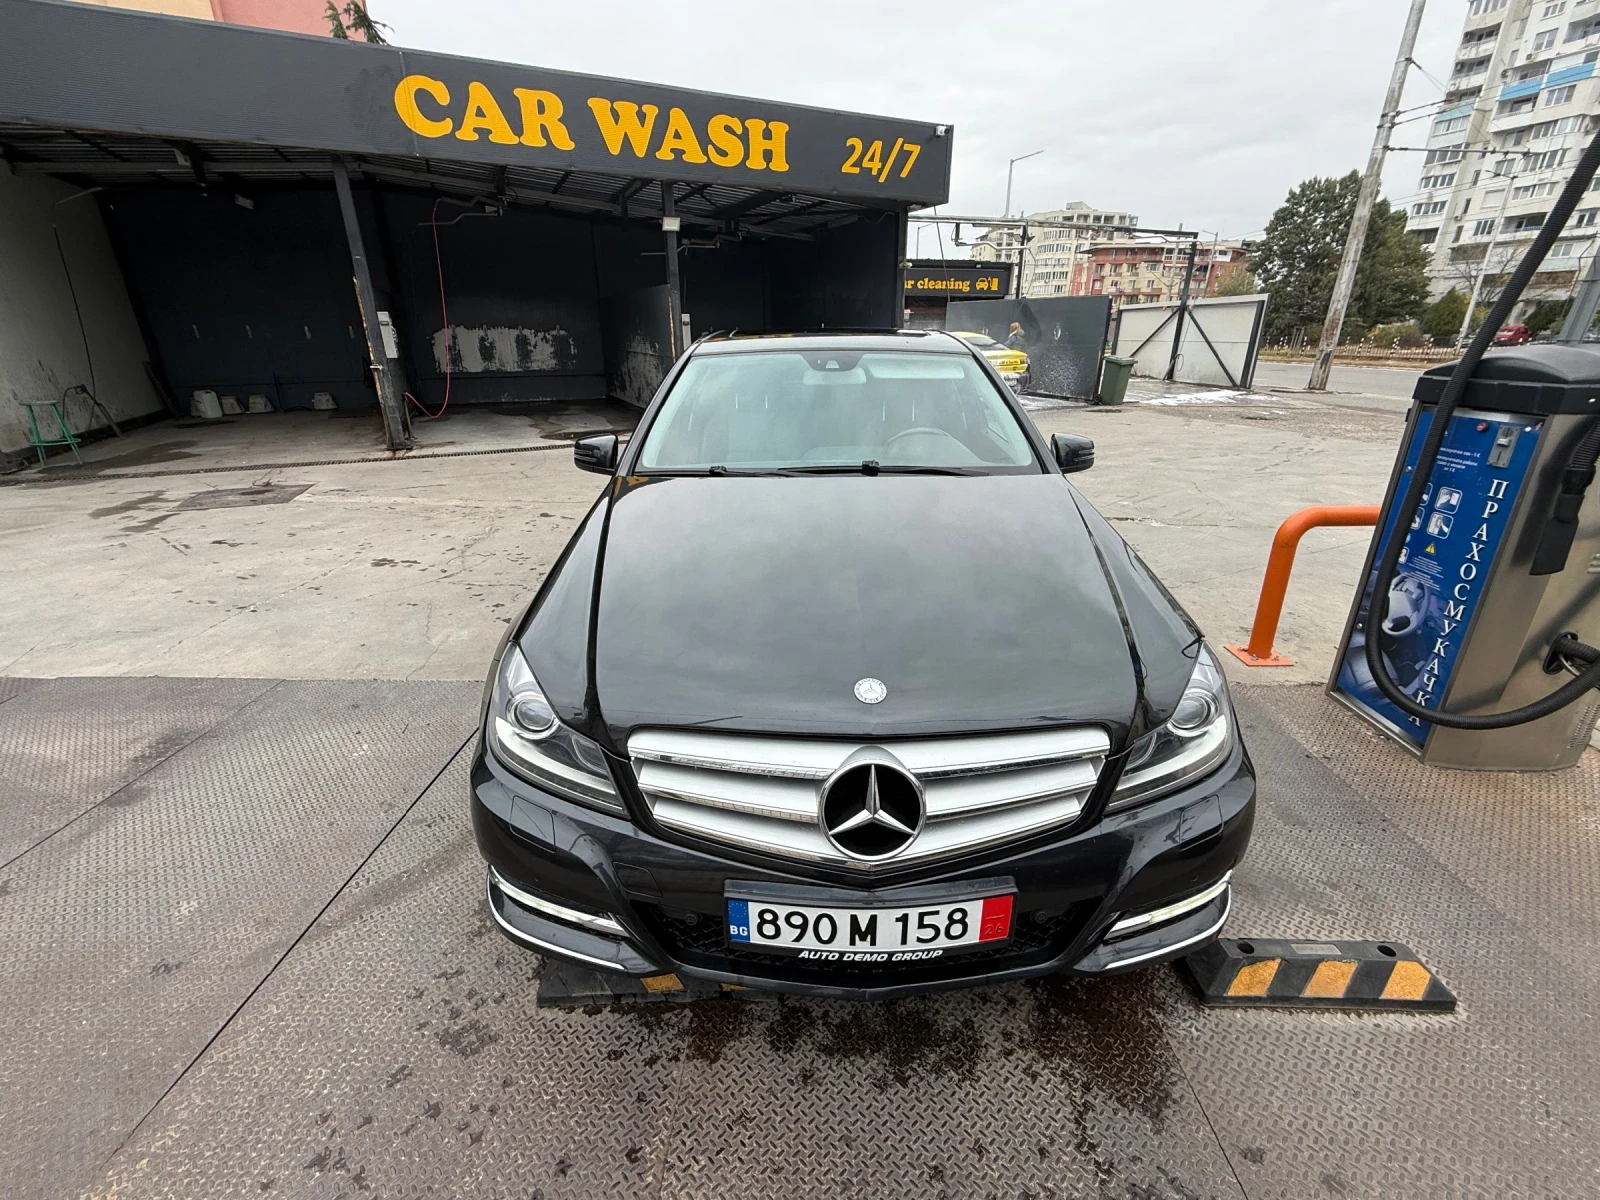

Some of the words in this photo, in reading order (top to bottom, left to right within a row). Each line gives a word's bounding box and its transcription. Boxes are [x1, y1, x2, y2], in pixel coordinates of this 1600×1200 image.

[395, 74, 575, 151] CAR
[588, 97, 789, 172] WASH
[841, 137, 922, 183] 24/7
[917, 277, 971, 292] cleaning
[730, 925, 748, 936] BG
[756, 908, 838, 945] 890
[849, 914, 878, 947] M
[895, 907, 969, 945] 158
[985, 922, 1004, 936] 26
[798, 950, 839, 961] AUTO
[842, 952, 888, 962] DEMO
[891, 950, 943, 961] GROUP
